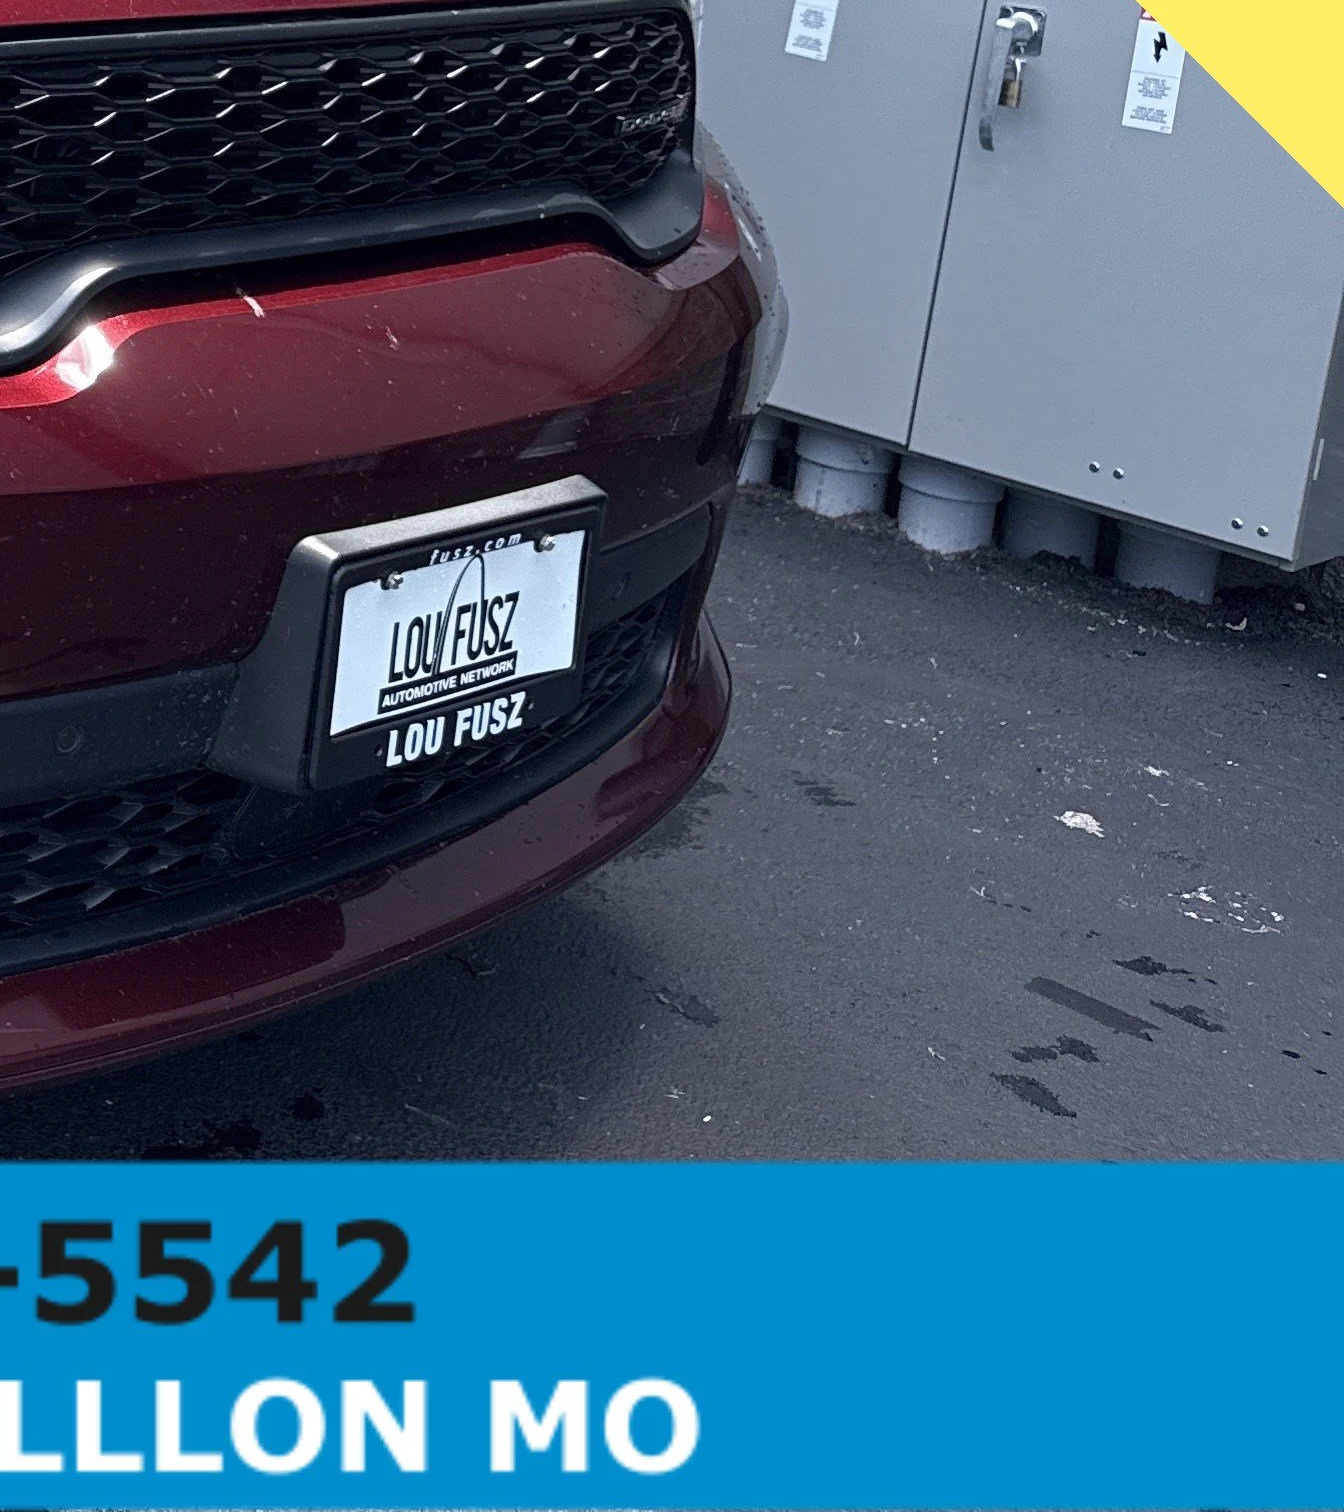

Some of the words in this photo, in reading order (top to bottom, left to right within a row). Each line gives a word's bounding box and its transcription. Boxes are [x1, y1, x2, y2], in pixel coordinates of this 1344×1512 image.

[429, 532, 522, 565] fusz.com
[388, 610, 443, 683] LOU
[451, 591, 520, 666] FUSZ
[381, 674, 457, 708] AUTOMOTIVE
[459, 657, 515, 685] NETWORK
[385, 716, 445, 768] LOU
[453, 691, 526, 747] FUSZ
